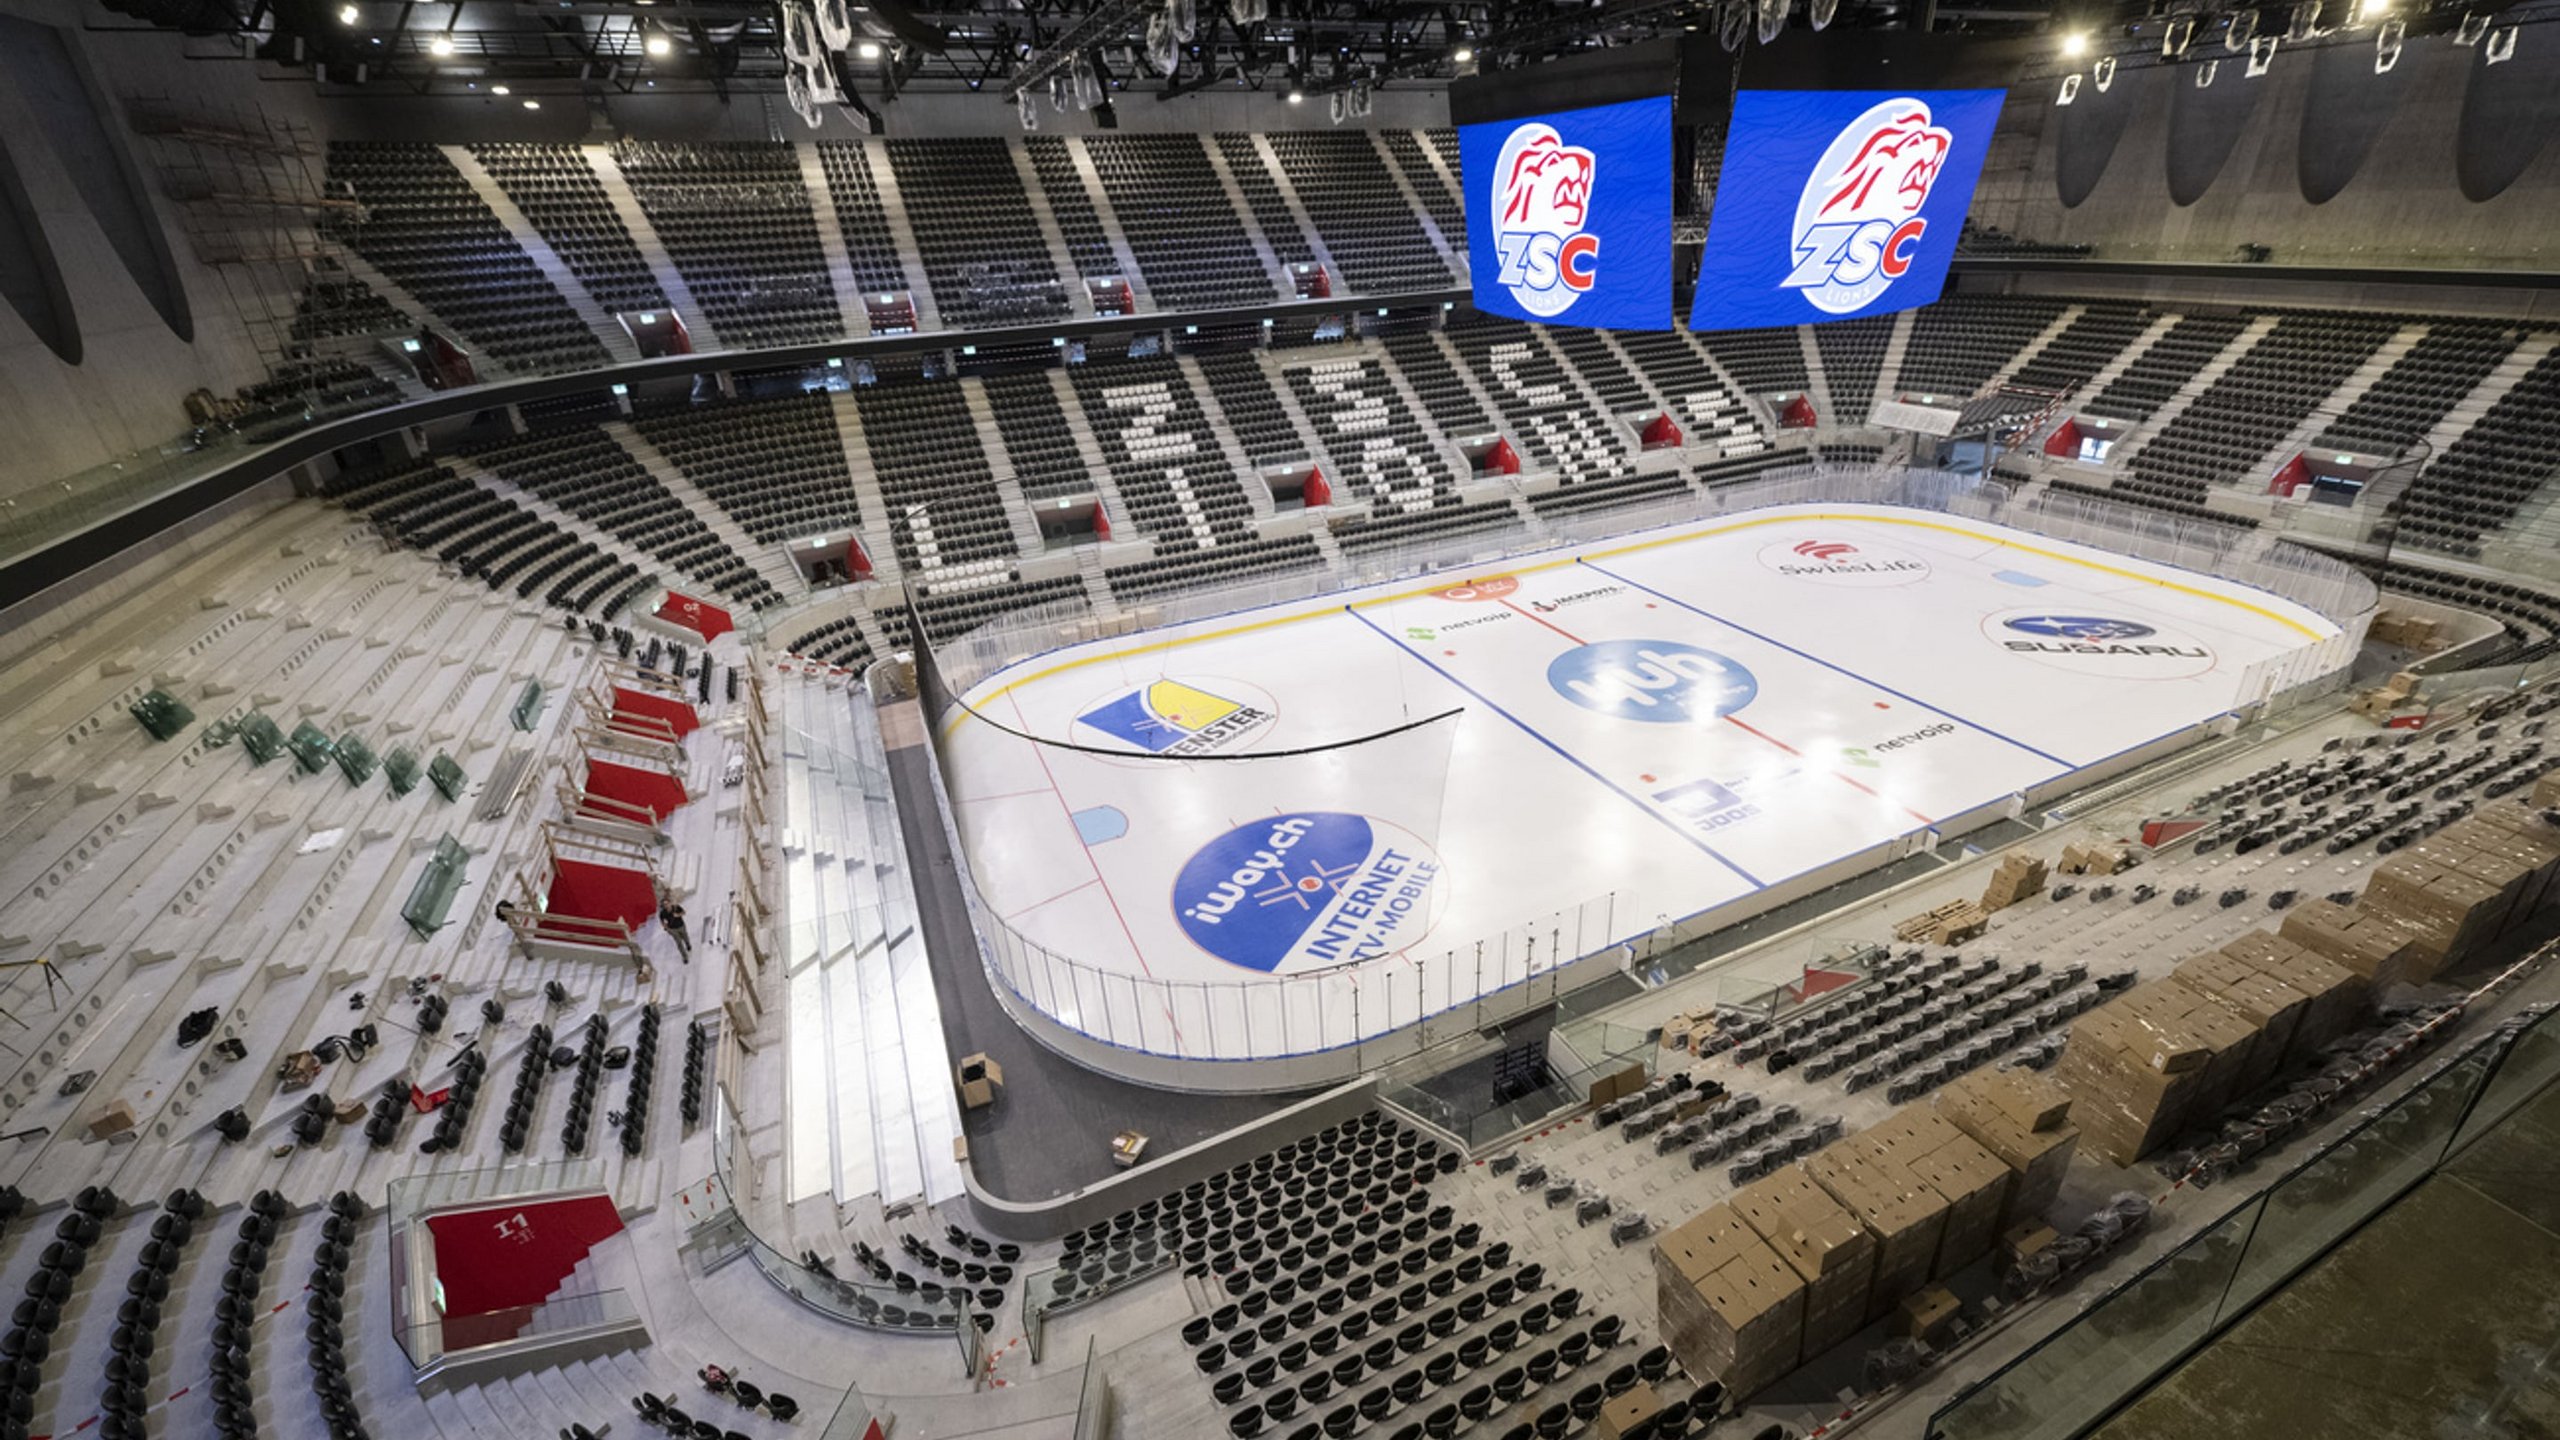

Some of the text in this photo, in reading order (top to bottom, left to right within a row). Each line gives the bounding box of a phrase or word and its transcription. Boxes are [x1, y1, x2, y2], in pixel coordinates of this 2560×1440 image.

[1497, 231, 1600, 291] ZSC
[1779, 217, 1928, 288] ZSC
[1825, 284, 1871, 305] LIONS
[1441, 612, 1512, 632] netvoip
[2003, 641, 2209, 657] SUBARU
[1874, 721, 1955, 753] netvoip
[1184, 818, 1314, 924] iway.ch
[1305, 848, 1411, 961] INTERNET
